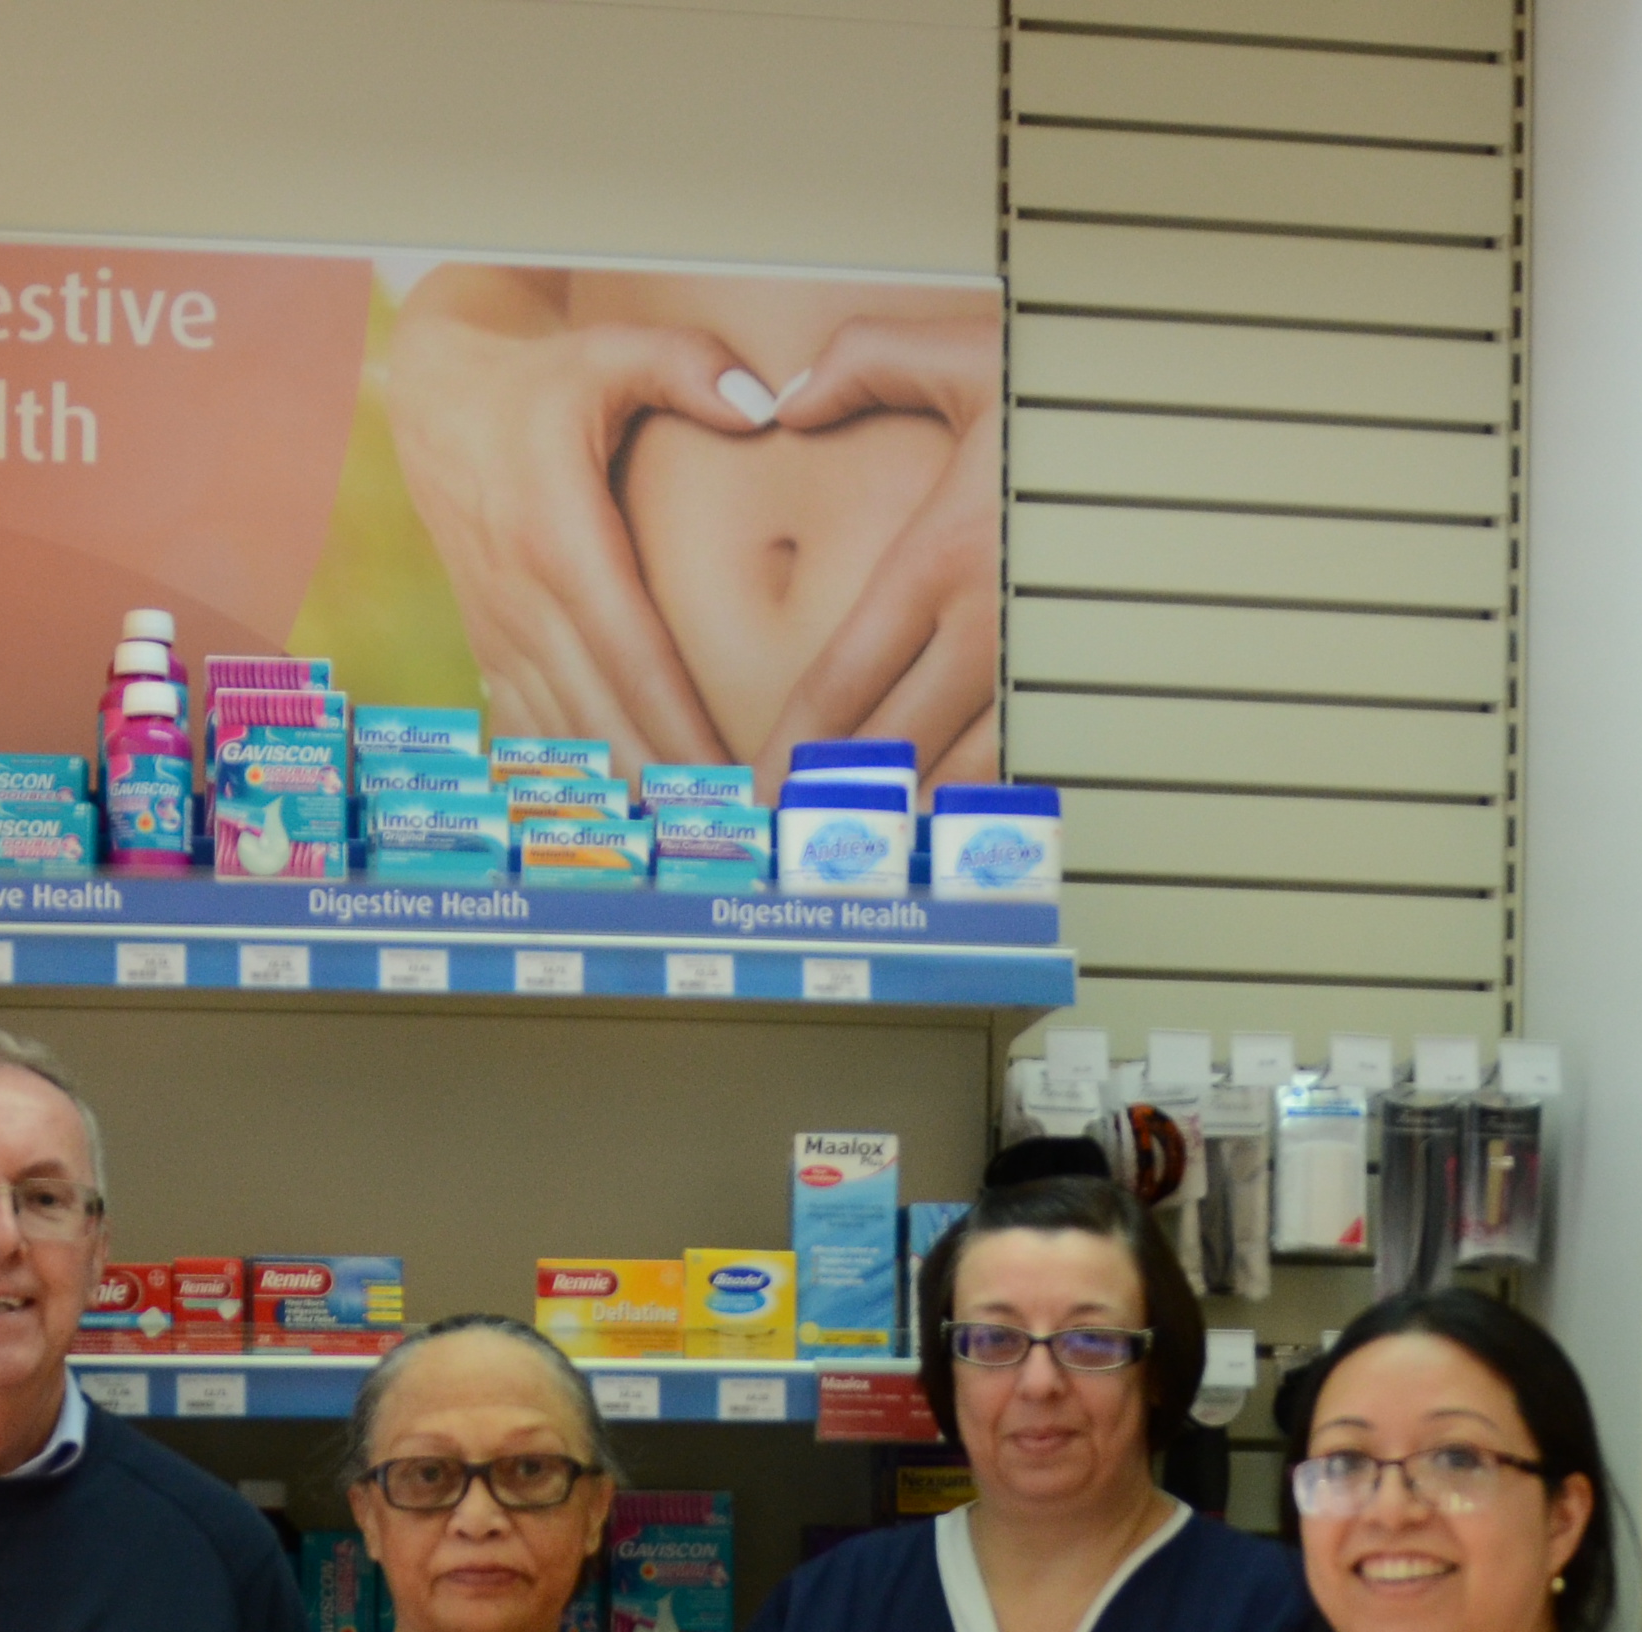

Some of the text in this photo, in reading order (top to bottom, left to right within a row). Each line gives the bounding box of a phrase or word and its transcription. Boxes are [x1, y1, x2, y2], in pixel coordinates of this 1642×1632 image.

[357, 725, 450, 745] Imodium
[222, 742, 331, 764] GAVISCON
[497, 746, 588, 766] Imodium
[108, 781, 180, 798] GAVISCON
[365, 773, 458, 792] Imodium
[645, 779, 738, 797] Imodium
[513, 786, 606, 805] Imodium
[381, 811, 478, 831] Imodium
[661, 820, 756, 841] Imodium
[529, 826, 625, 847] Imodium
[802, 835, 890, 862] Andrews
[958, 842, 1044, 868] Andrews
[33, 884, 121, 911] Health
[308, 886, 528, 920] Digestive Health
[711, 899, 927, 931] Digestive Health
[805, 1136, 884, 1157] Maalox
[180, 1280, 224, 1295] Rennie
[261, 1269, 323, 1290] Rennie
[553, 1273, 610, 1291] Rennie
[592, 1302, 678, 1323] Deflatine
[821, 1376, 870, 1391] Maalox
[619, 1540, 718, 1558] GAVISCON
